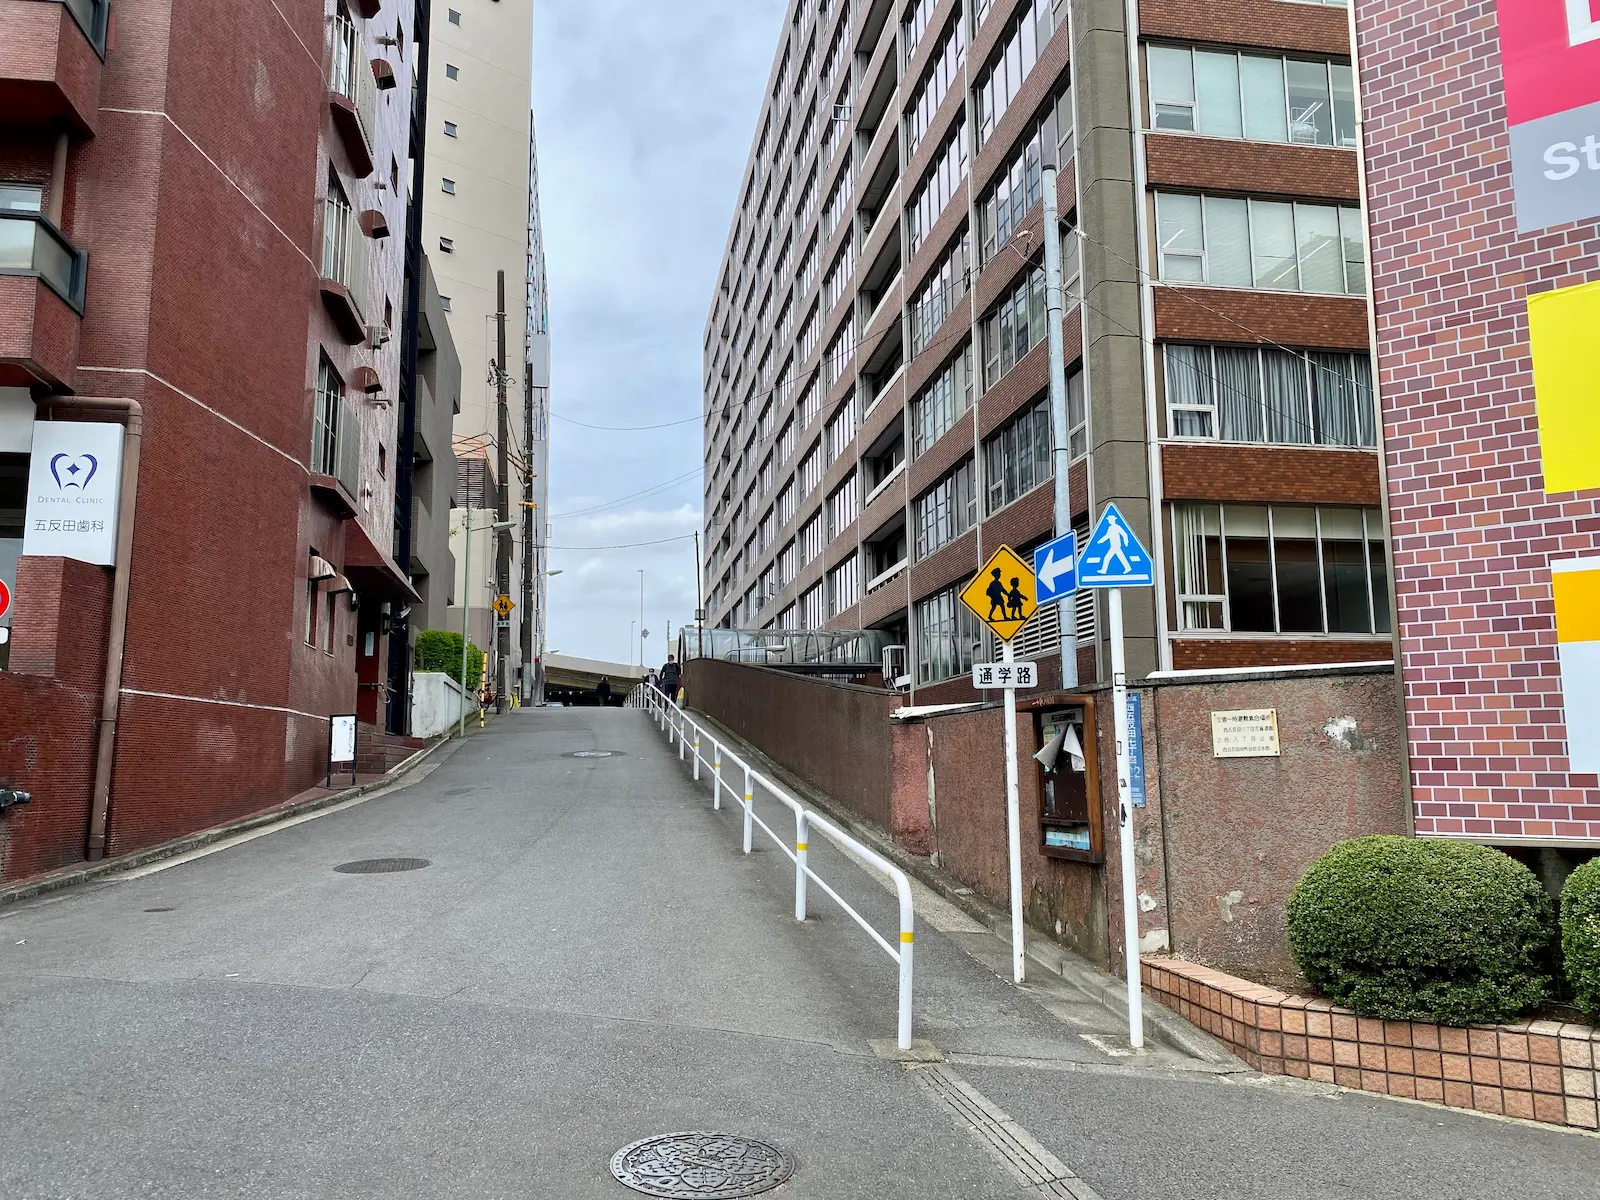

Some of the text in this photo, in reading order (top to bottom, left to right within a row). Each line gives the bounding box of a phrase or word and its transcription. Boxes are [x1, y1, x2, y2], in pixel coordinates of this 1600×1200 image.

[75, 496, 103, 504] CLINIC
[33, 519, 104, 532] 五反田歯科
[979, 666, 1031, 684] 通学路
